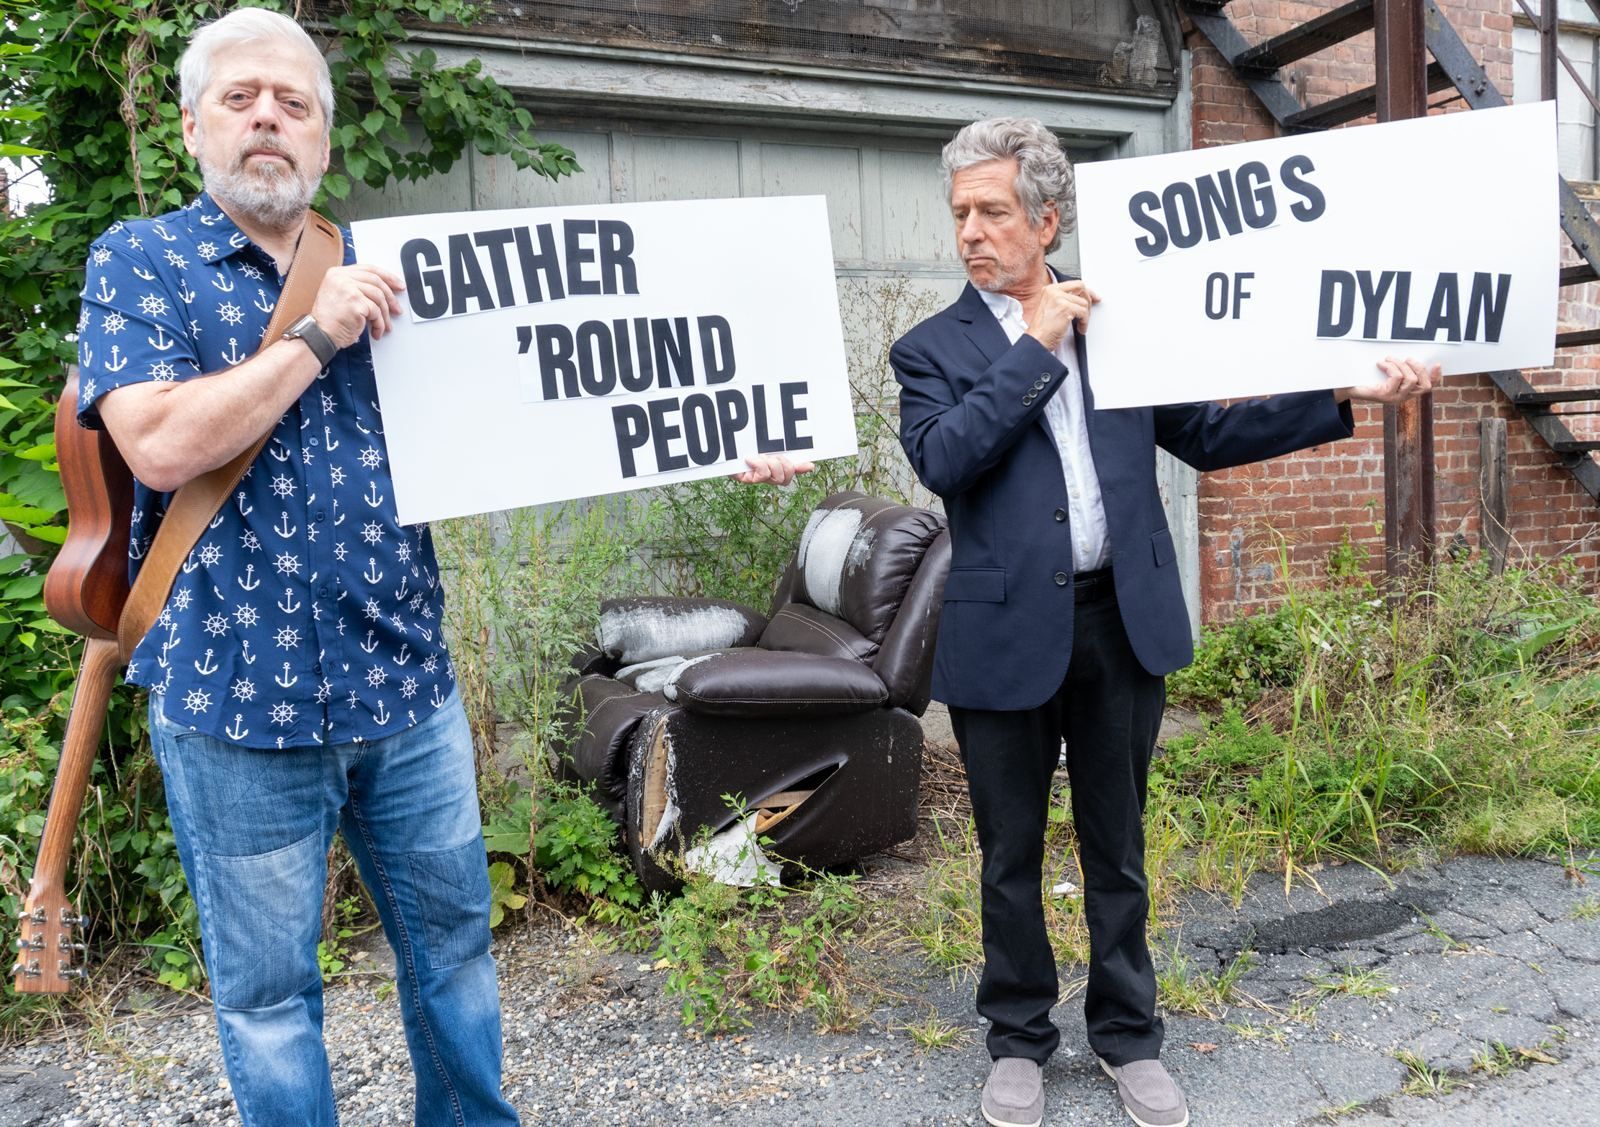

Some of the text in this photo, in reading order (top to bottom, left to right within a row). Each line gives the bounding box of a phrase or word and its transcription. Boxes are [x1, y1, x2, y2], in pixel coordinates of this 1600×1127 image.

[1129, 154, 1326, 257] SONGS
[400, 219, 640, 319] GATHER
[1205, 270, 1512, 343] OF DYLAN
[611, 381, 814, 479] PEOPLE
